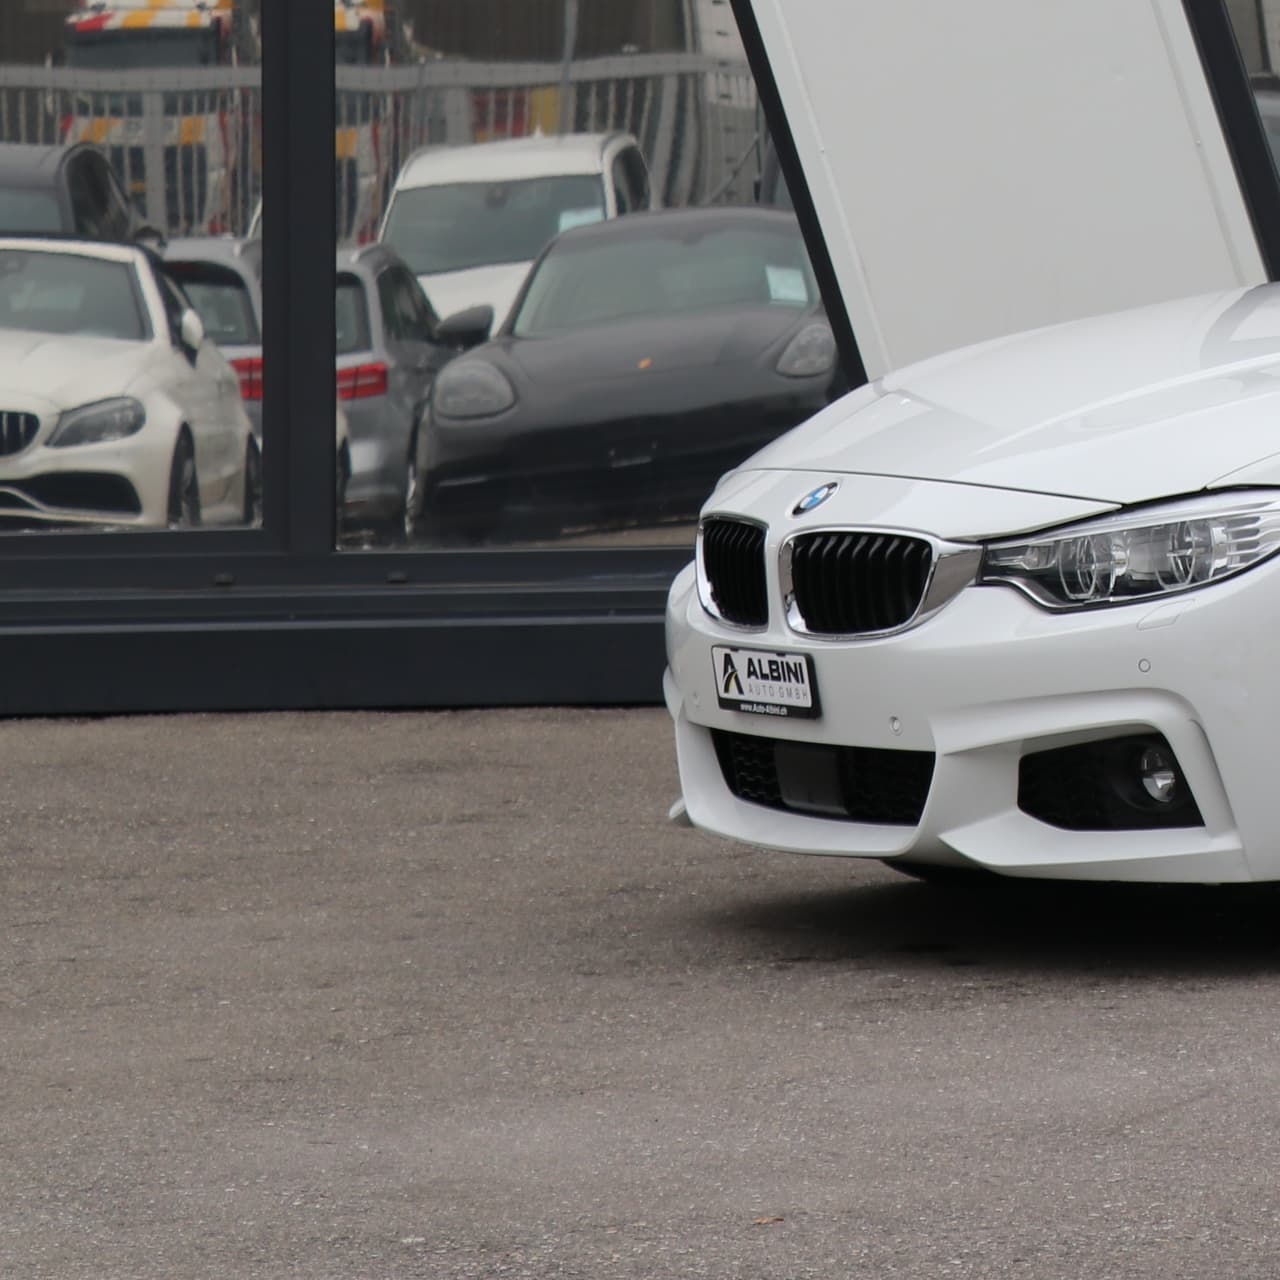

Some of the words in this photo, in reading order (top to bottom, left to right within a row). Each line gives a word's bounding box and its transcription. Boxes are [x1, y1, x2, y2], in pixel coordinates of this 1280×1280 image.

[746, 657, 805, 685] ALBINI
[748, 683, 775, 698] AUTO
[779, 686, 809, 701] GMBH
